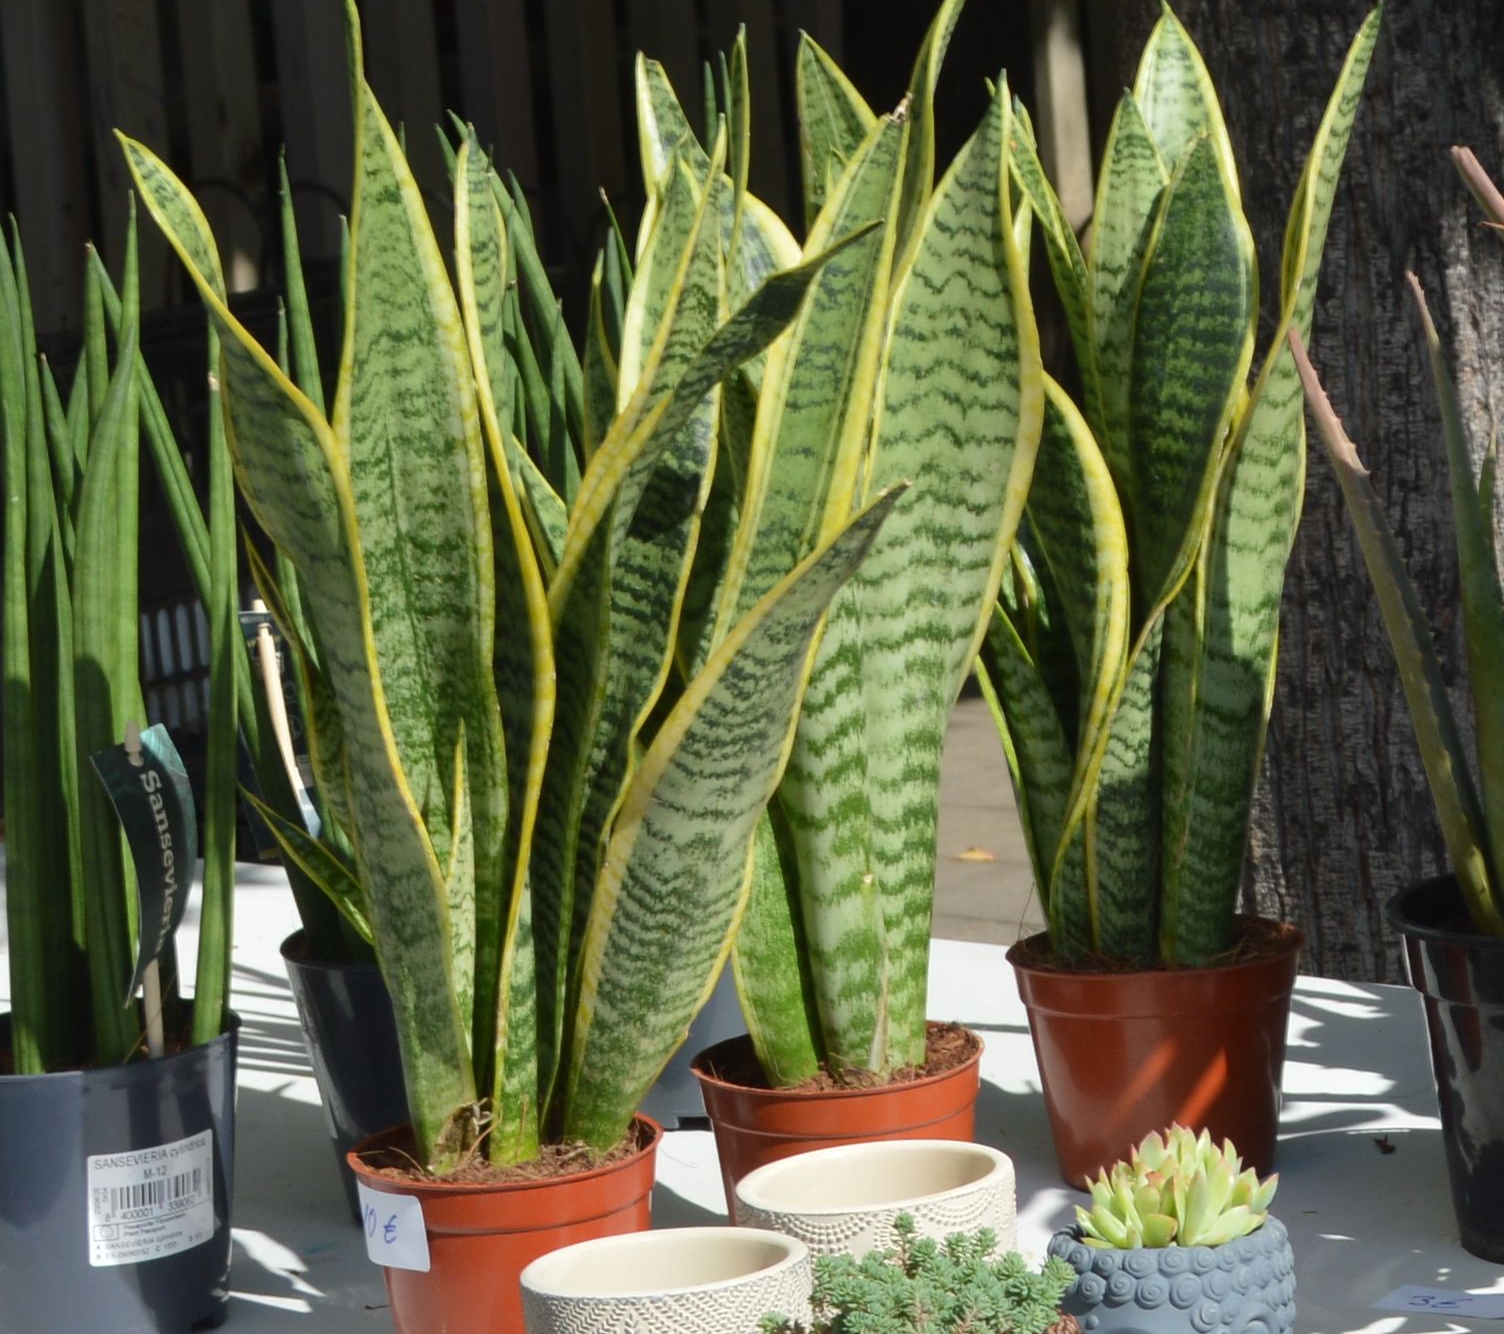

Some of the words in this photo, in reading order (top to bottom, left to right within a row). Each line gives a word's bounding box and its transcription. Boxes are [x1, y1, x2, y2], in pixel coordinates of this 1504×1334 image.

[94, 1149, 169, 1170] SANSEVIERIA
[144, 1166, 167, 1180] M-12
[1408, 1295, 1473, 1308] 3€
